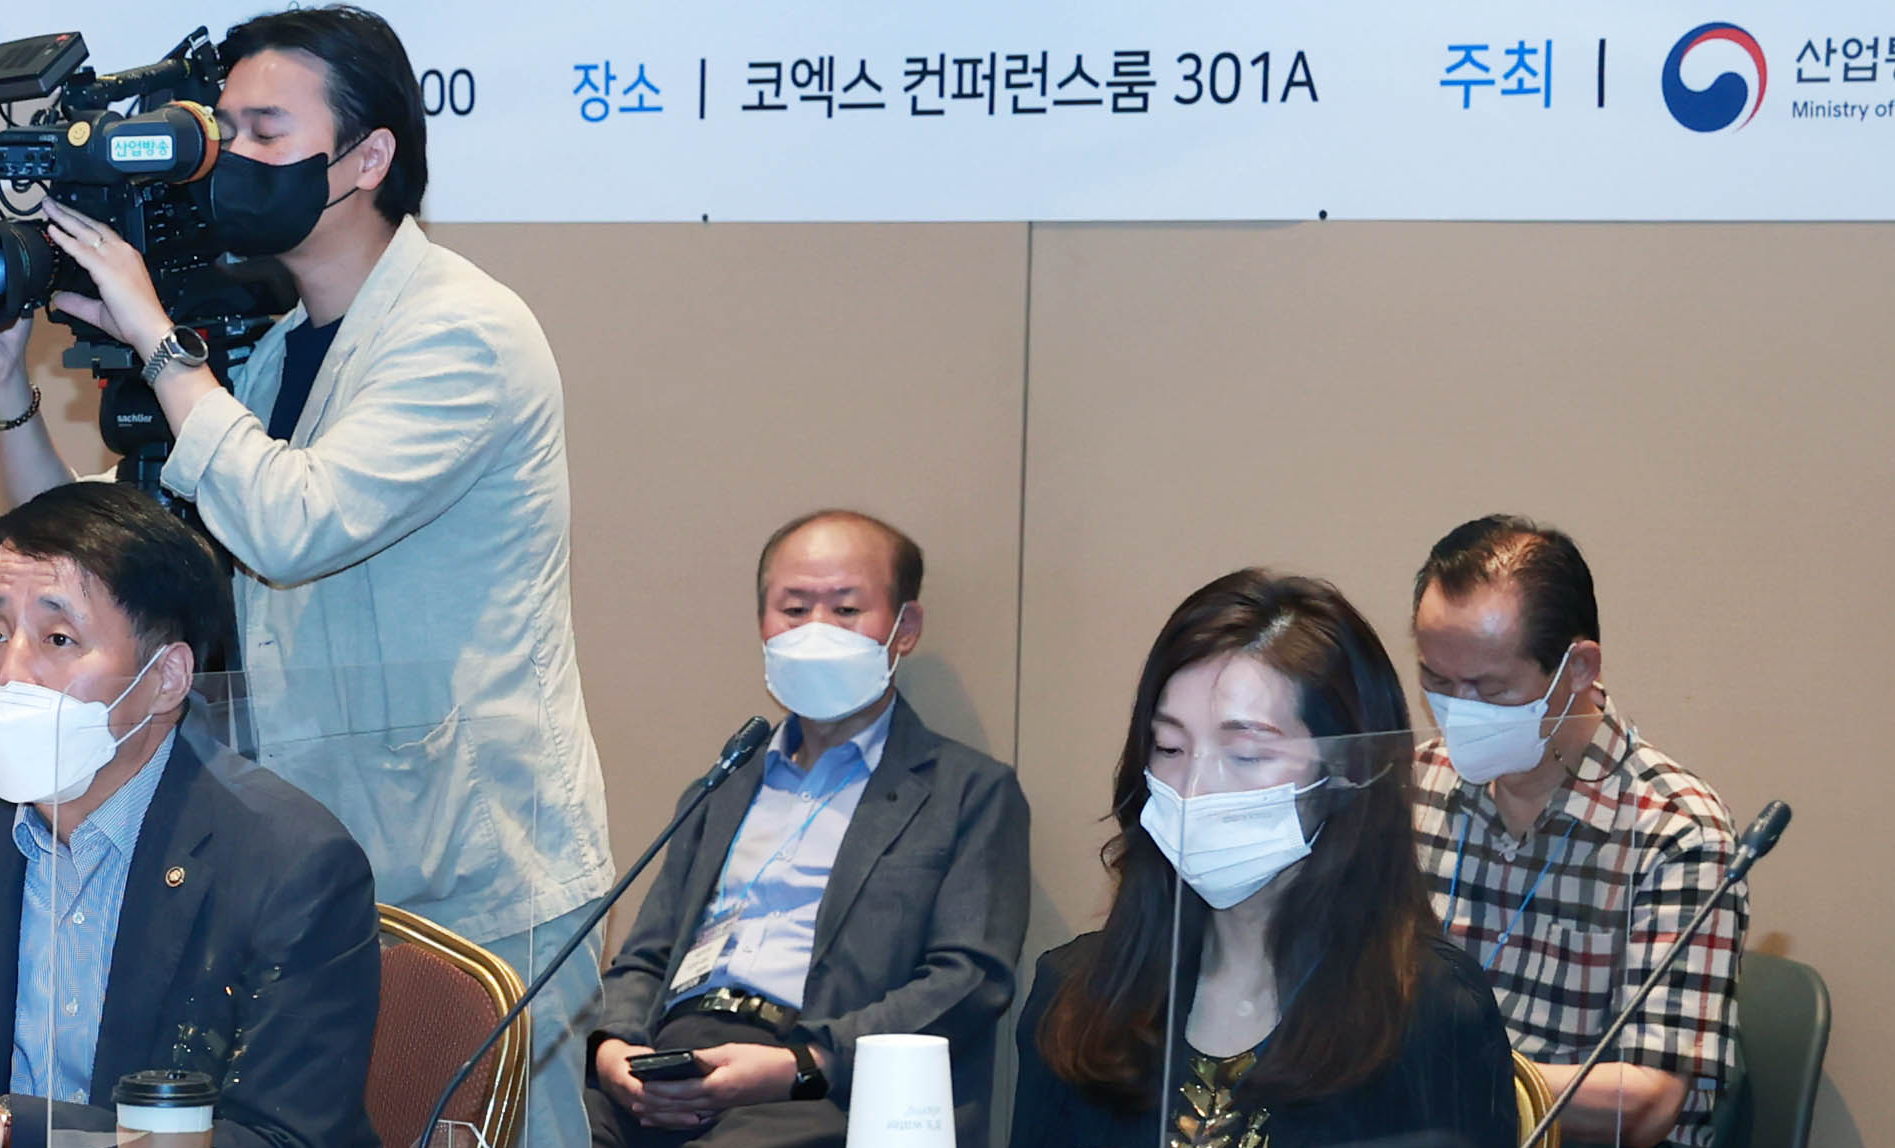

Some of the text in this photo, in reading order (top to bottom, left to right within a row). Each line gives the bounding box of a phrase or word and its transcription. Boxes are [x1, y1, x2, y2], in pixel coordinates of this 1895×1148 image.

[572, 49, 1319, 123] 장소 코엑스 컨퍼런스룸 301A
[1439, 39, 1553, 110] 주최
[1792, 99, 1895, 121] Ministry of
[114, 139, 170, 158] 산업방송
